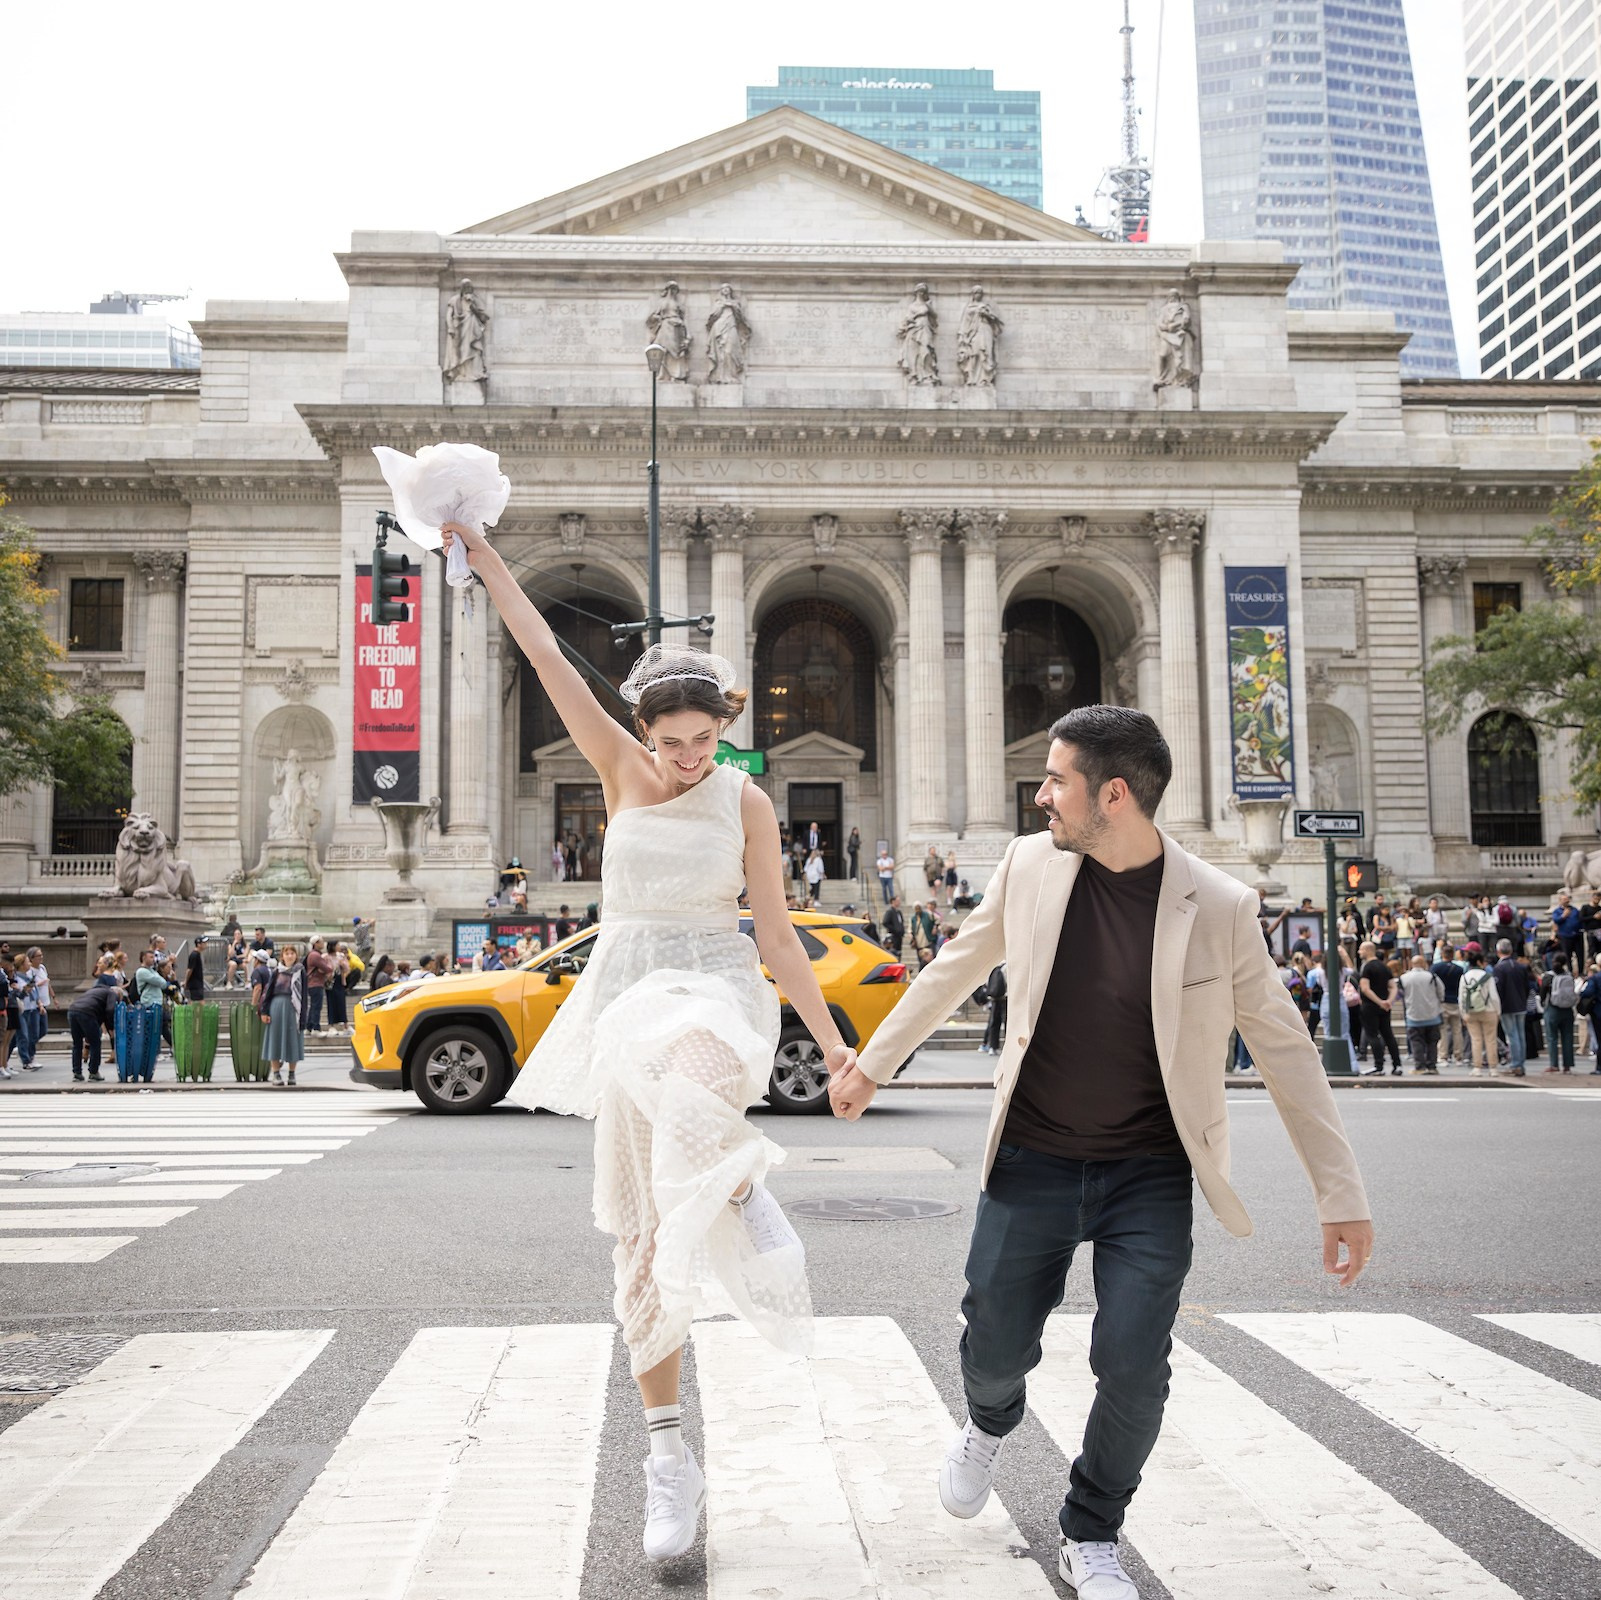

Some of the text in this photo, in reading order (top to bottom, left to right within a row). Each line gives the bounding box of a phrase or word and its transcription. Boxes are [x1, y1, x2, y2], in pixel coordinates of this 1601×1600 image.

[842, 77, 933, 89] salesforce
[536, 304, 578, 315] ASTOR
[585, 304, 641, 315] LIBRARY
[838, 306, 892, 319] LIBRARY
[1098, 309, 1138, 321] TRUST
[598, 461, 649, 478] THE
[670, 461, 732, 478] NEW
[755, 462, 819, 479] YORK
[841, 463, 927, 479] PUBLIC
[951, 463, 1054, 480] LIBRARY
[1229, 593, 1284, 602] TREASURES
[376, 625, 399, 644] THE
[359, 646, 416, 666] FREEDOM
[379, 667, 395, 687] TO
[371, 689, 403, 709] READ
[359, 722, 415, 733] #FreedomToRead
[724, 757, 750, 770] Ave
[1308, 820, 1352, 829] ONE WAY
[458, 926, 487, 934] BOOKS
[498, 926, 540, 934] FREEDM
